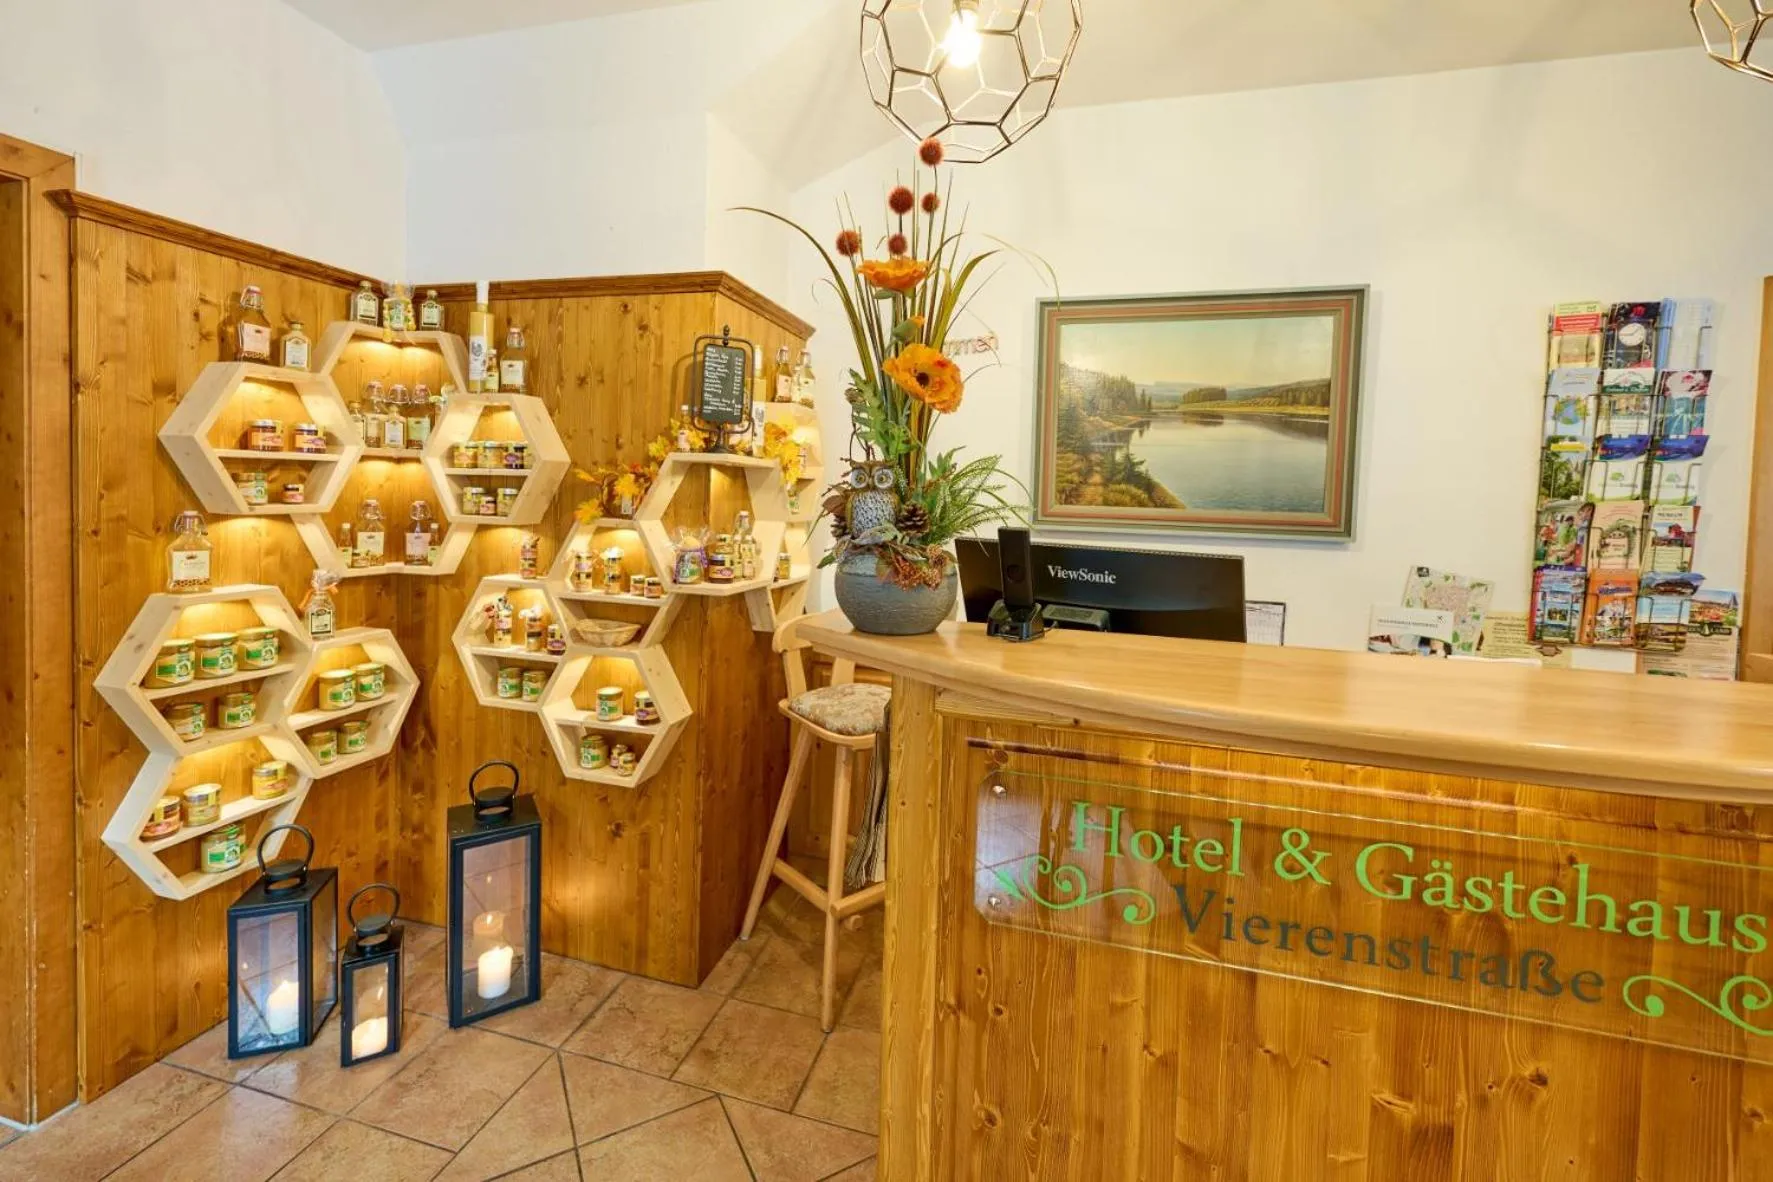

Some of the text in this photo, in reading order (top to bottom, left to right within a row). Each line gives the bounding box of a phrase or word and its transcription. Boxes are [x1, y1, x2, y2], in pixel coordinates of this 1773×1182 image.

[1048, 565, 1117, 584] ViewSonic
[1072, 801, 1768, 953] Hotel & Gästehaus
[1171, 884, 1605, 1004] Vierenstraße
